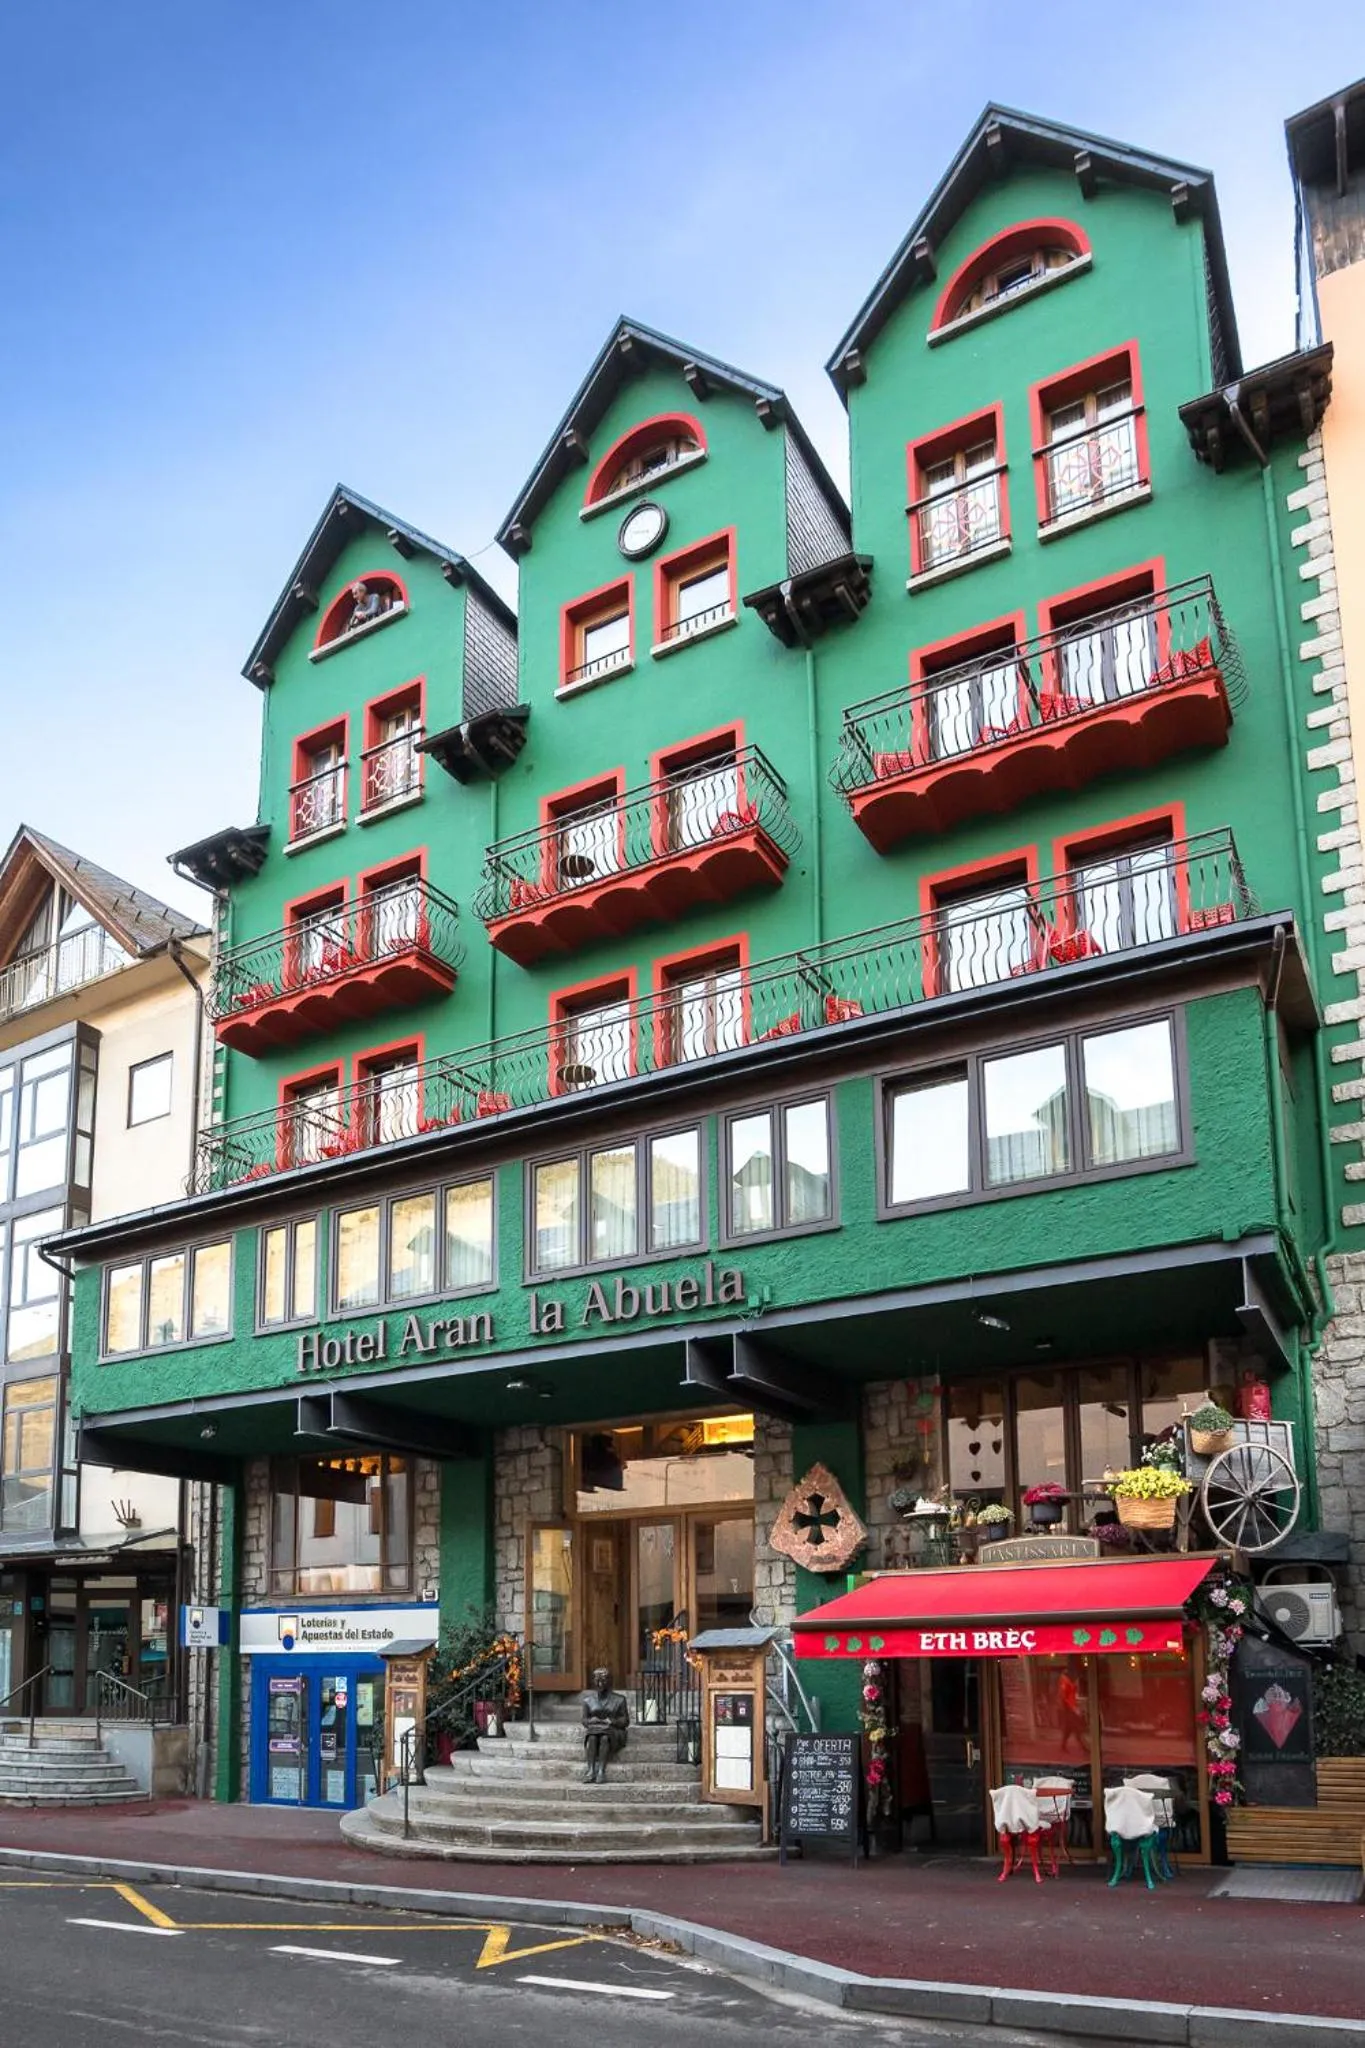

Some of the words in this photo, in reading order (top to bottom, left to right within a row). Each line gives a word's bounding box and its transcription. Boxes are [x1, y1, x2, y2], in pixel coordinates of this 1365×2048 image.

[296, 1320, 388, 1373] Hotel
[399, 1311, 495, 1356] Aran
[528, 1292, 565, 1335] la
[582, 1260, 746, 1326] Abuela
[301, 1617, 337, 1628] Loterías
[340, 1619, 347, 1630] y
[301, 1630, 343, 1642] Apuestas
[345, 1628, 359, 1640] del
[361, 1629, 394, 1640] Estado
[919, 1632, 968, 1650] ETH
[973, 1628, 1037, 1651] BRÈÇ
[813, 1738, 852, 1752] OFERTA
